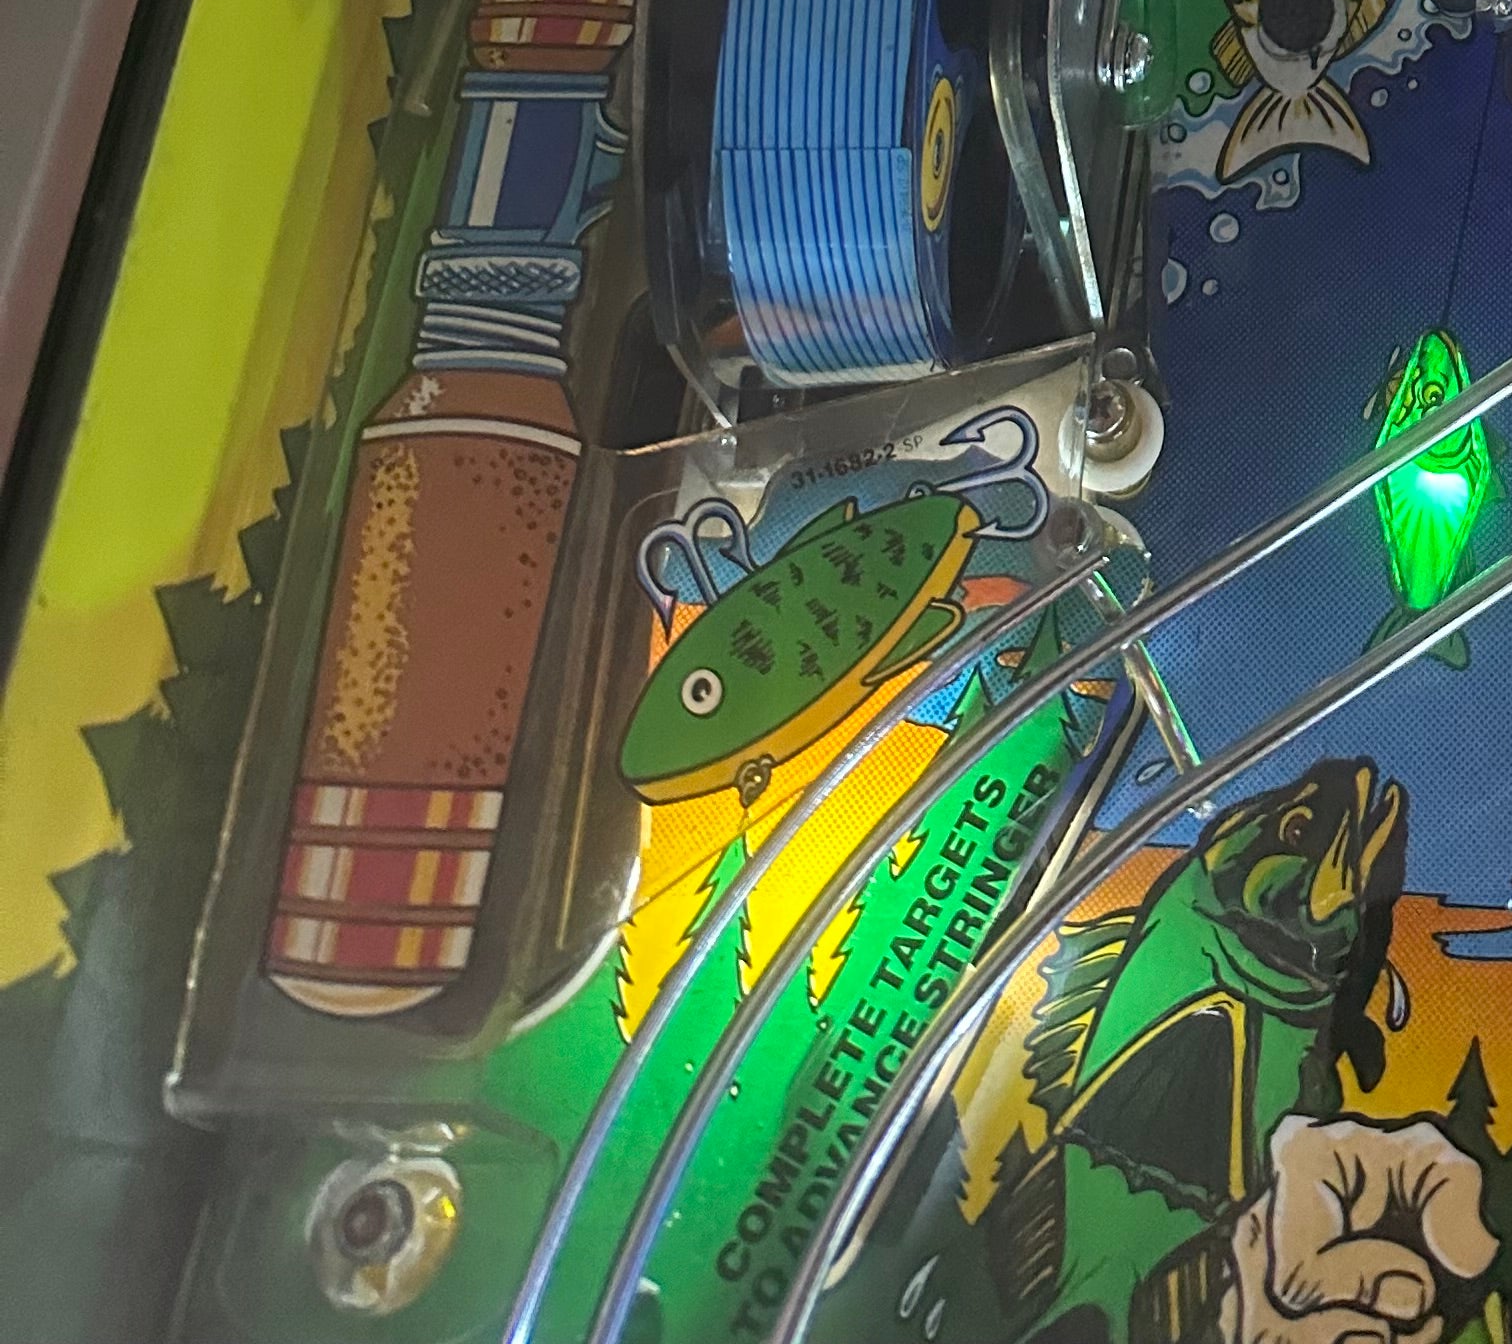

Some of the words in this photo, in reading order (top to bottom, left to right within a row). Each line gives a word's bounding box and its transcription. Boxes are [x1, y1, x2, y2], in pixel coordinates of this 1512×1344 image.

[717, 996, 888, 1283] COMPLETE
[870, 774, 1007, 1009] TARGETS
[781, 1012, 930, 1262] ADVANCE
[914, 760, 1062, 1010] STRINGER
